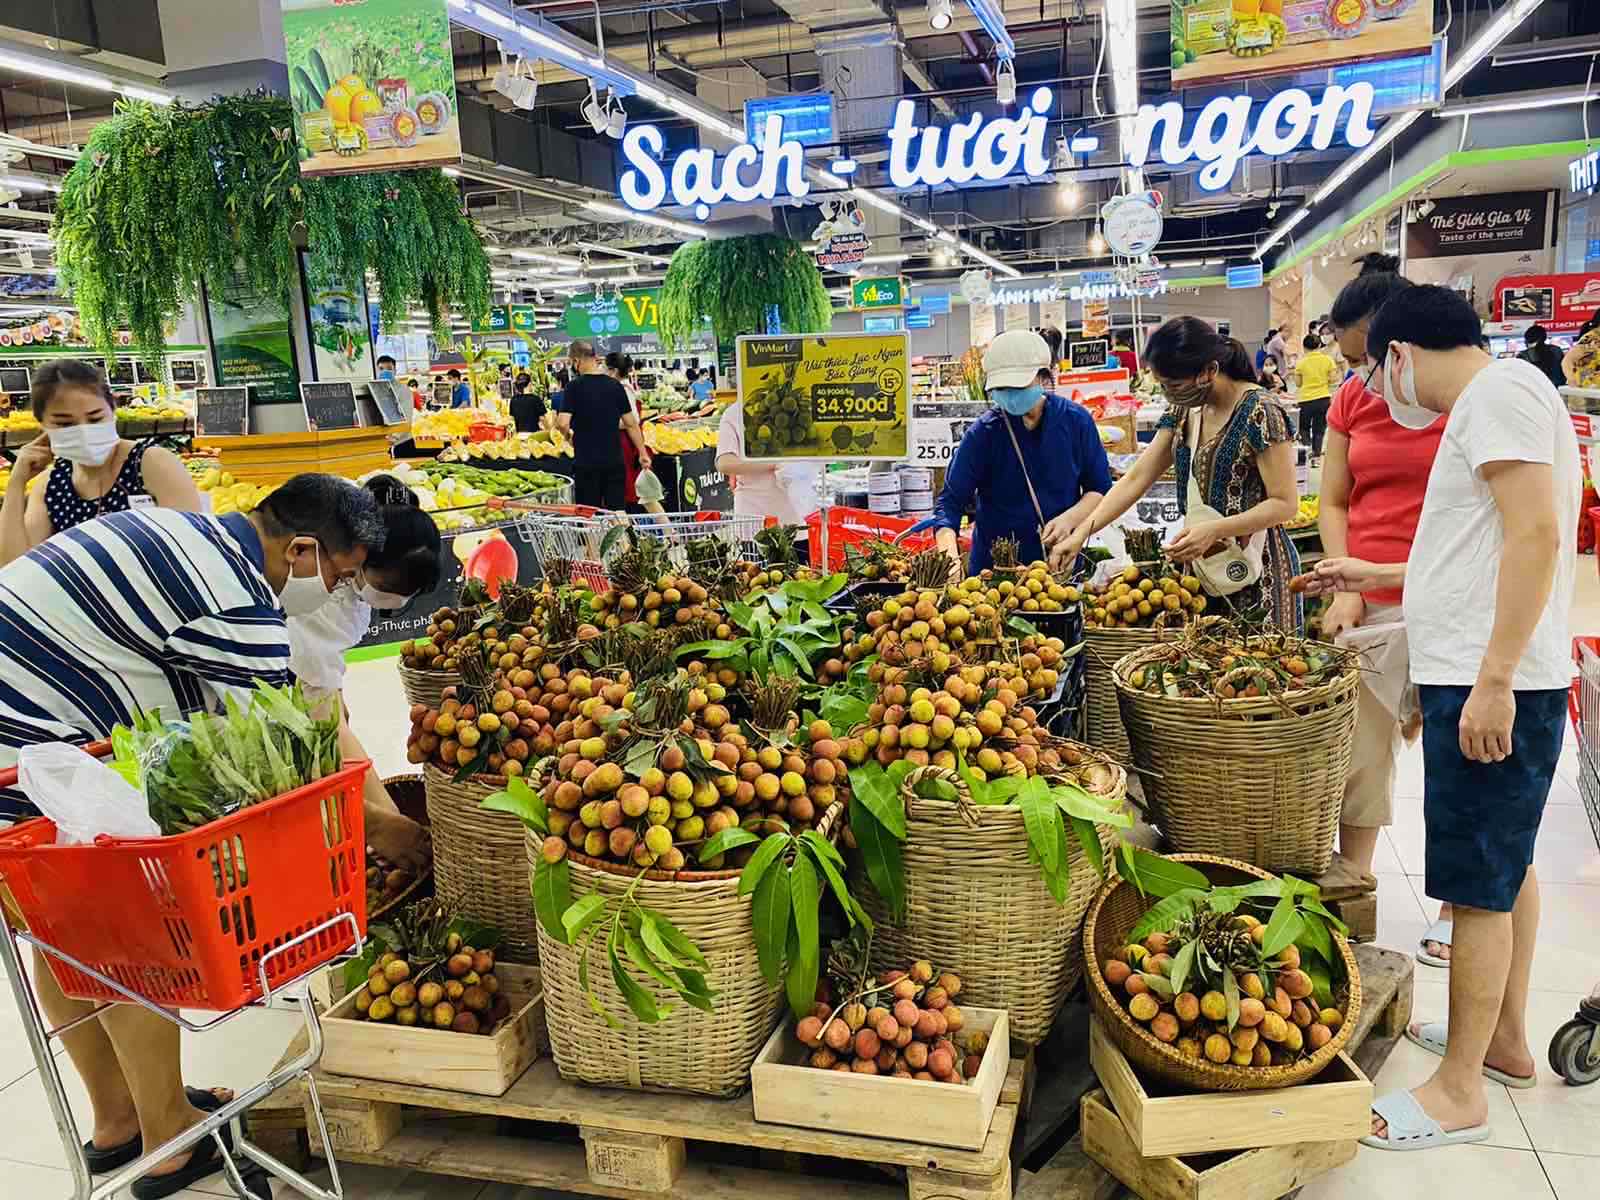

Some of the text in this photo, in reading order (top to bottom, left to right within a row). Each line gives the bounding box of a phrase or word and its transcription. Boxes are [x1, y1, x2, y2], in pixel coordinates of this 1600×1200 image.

[618, 115, 809, 220] Sạch
[887, 86, 1053, 188] tươi
[1122, 81, 1377, 191] ngon
[1430, 212, 1457, 229] Thế
[1457, 211, 1486, 230] Giới
[1487, 210, 1513, 228] Gia
[1440, 229, 1524, 242] Taste of the world
